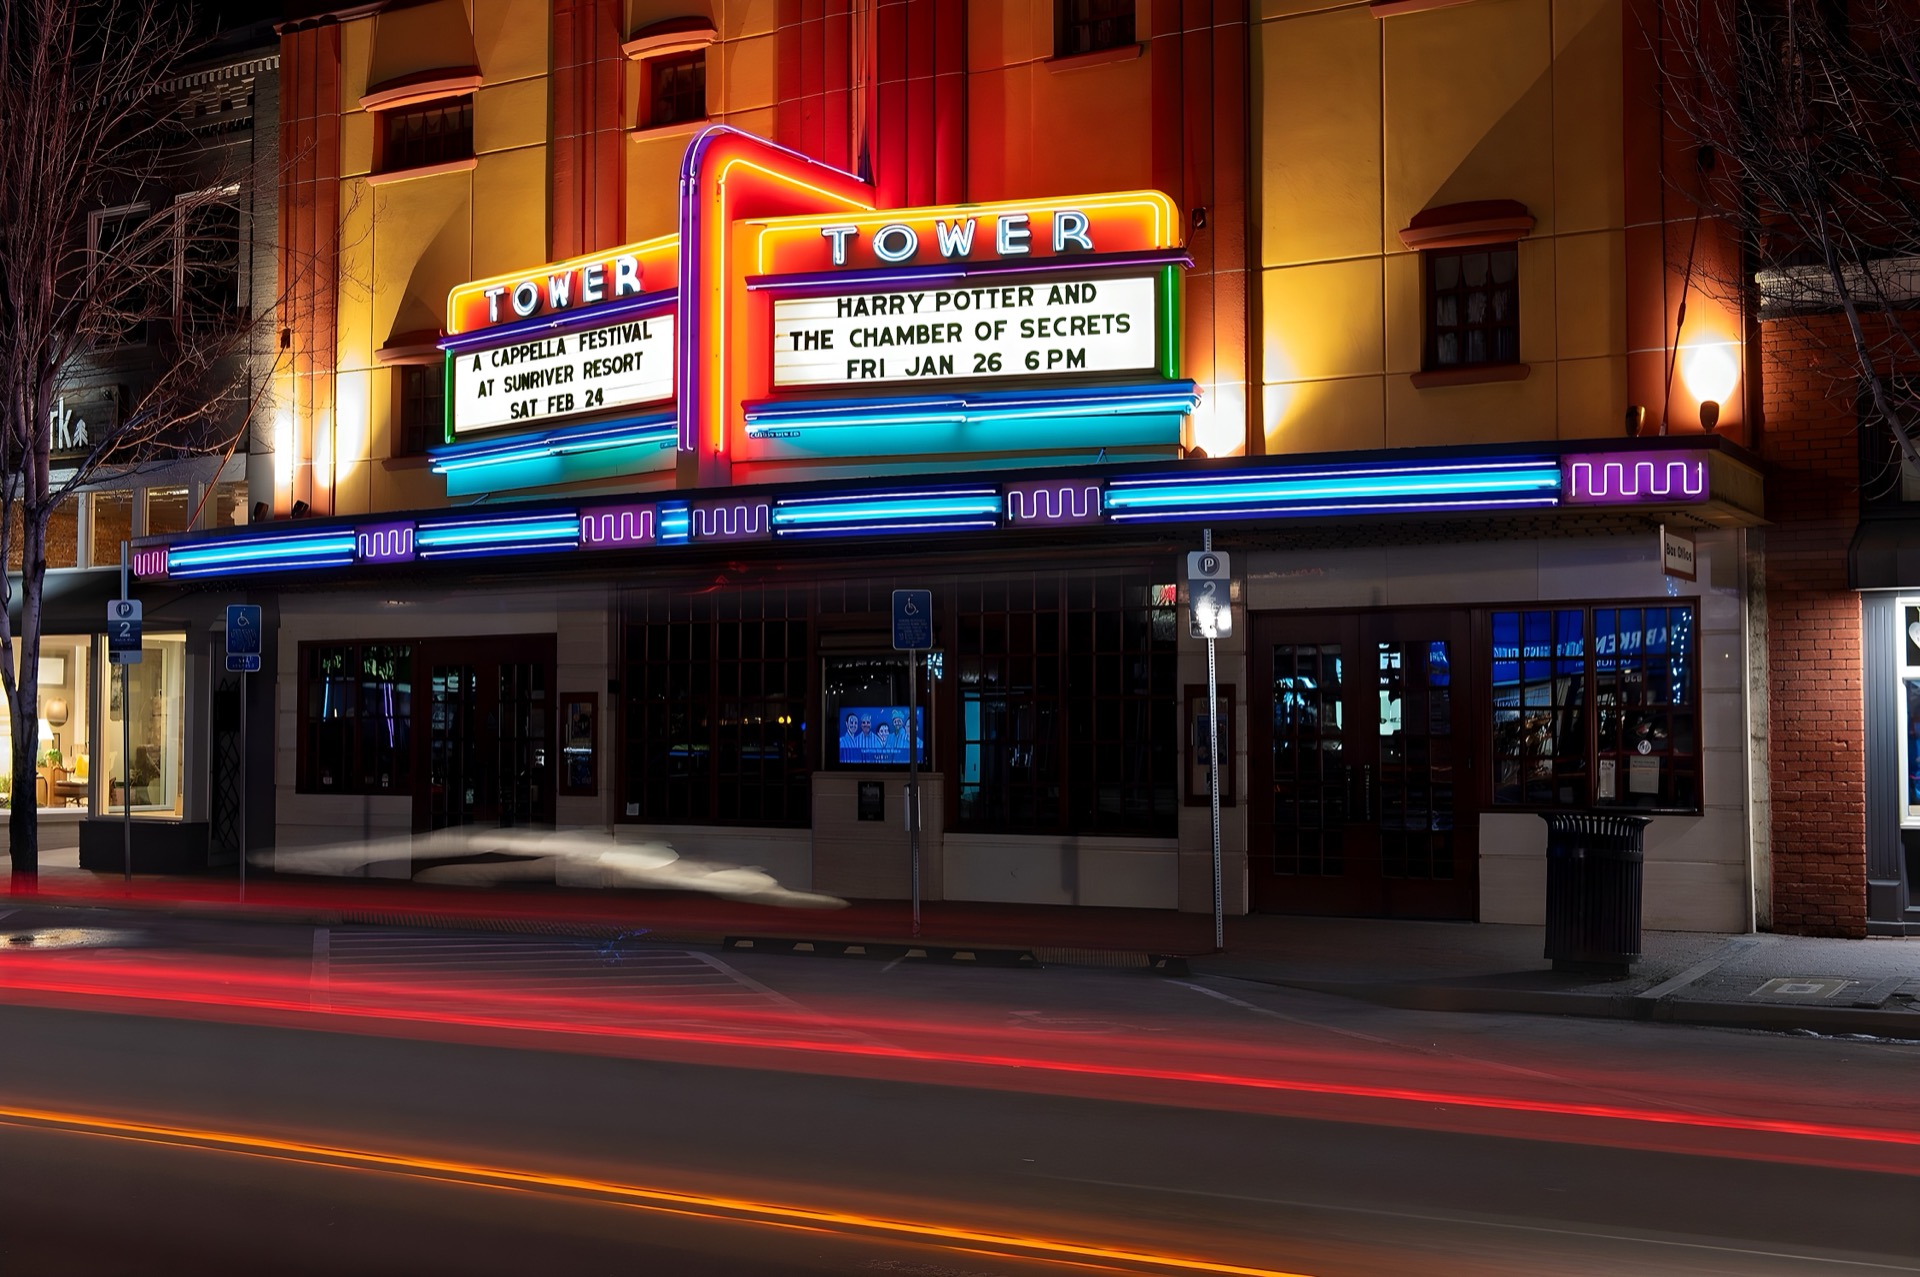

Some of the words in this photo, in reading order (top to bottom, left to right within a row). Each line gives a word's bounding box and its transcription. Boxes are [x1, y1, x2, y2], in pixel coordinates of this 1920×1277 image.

[821, 211, 1094, 266] TOWER
[484, 255, 642, 323] TOWER
[837, 293, 925, 318] HARRY
[936, 286, 1034, 312] POTTER
[1047, 283, 1097, 306] AND
[473, 354, 482, 372] A
[491, 338, 567, 367] CAPPELLA
[579, 321, 652, 352] FESTIVAL
[789, 329, 834, 351] THE
[849, 322, 963, 348] CHAMBER
[975, 320, 1008, 341] OF
[1020, 313, 1131, 339] SECRETS
[478, 379, 494, 399] AT
[504, 364, 574, 393] SUNRIVER
[583, 351, 643, 380] RESORT
[847, 358, 885, 380] FRI
[905, 354, 954, 376] JAN
[973, 352, 1002, 373] 26
[510, 398, 538, 419] SAT
[548, 393, 574, 414] FEB
[585, 388, 604, 408] 24
[49, 397, 72, 450] rk
[1204, 558, 1214, 572] P
[1202, 581, 1217, 599] 2
[120, 622, 131, 637] 2
